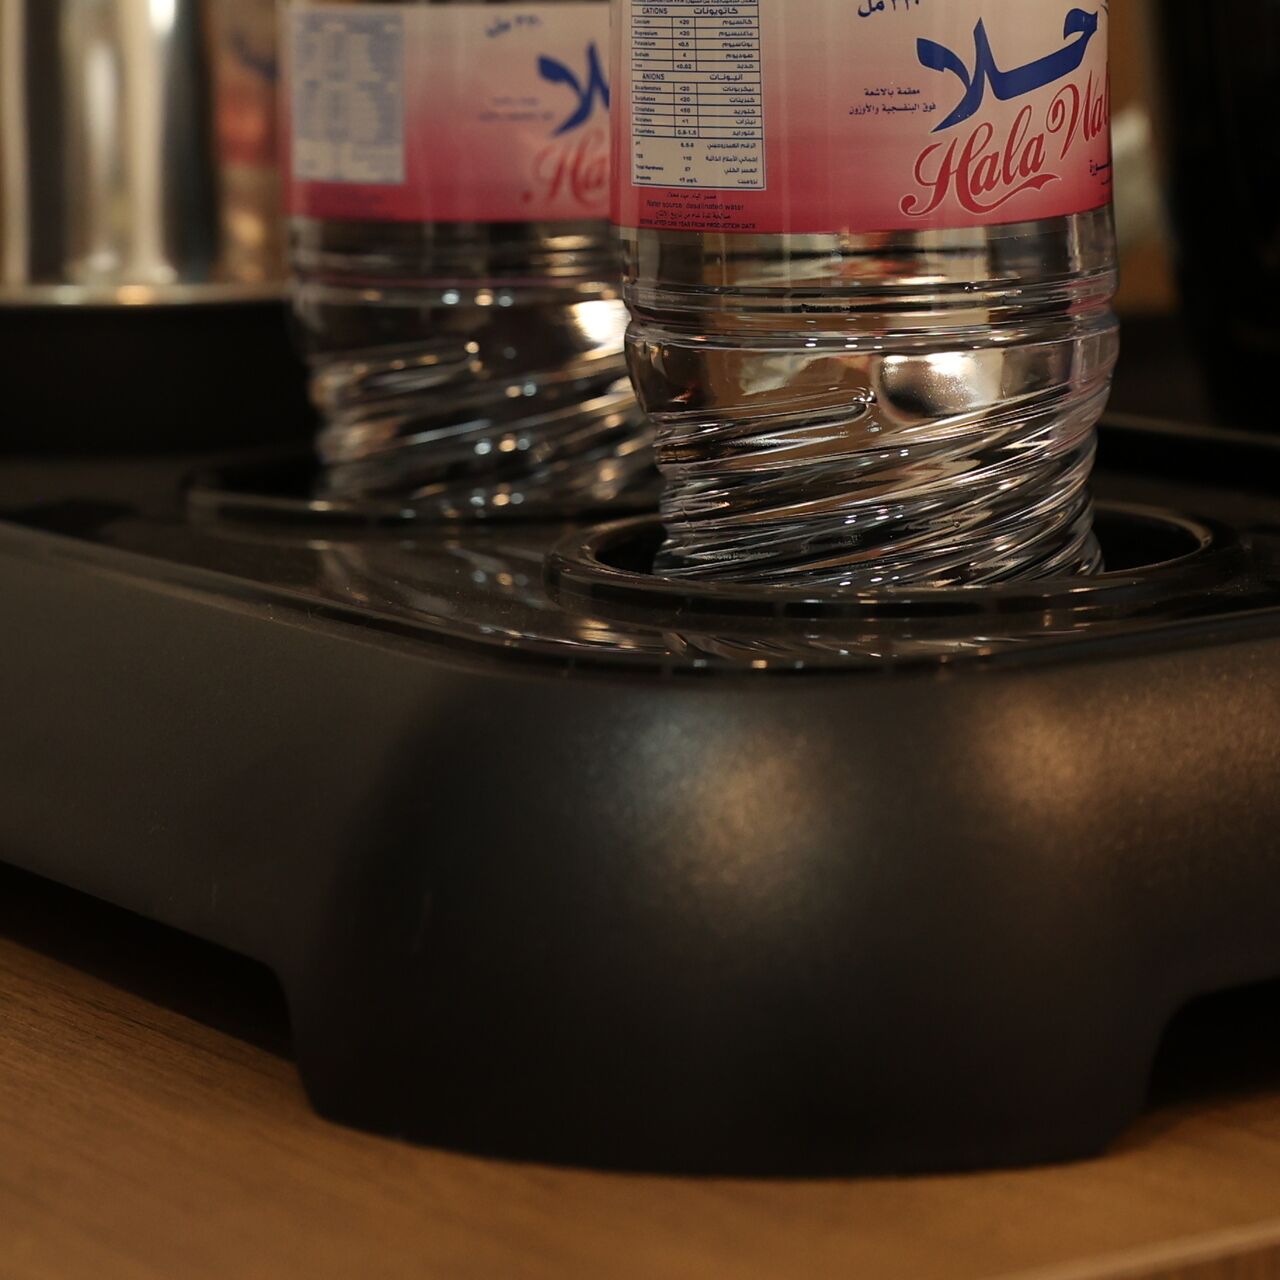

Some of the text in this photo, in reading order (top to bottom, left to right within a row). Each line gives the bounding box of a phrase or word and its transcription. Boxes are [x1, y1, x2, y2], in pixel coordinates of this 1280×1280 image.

[641, 7, 669, 15] CATIONS
[915, 6, 1099, 133] حلا
[642, 73, 665, 81] ANIONS
[922, 102, 937, 114] فوق
[900, 104, 1060, 217] Hala
